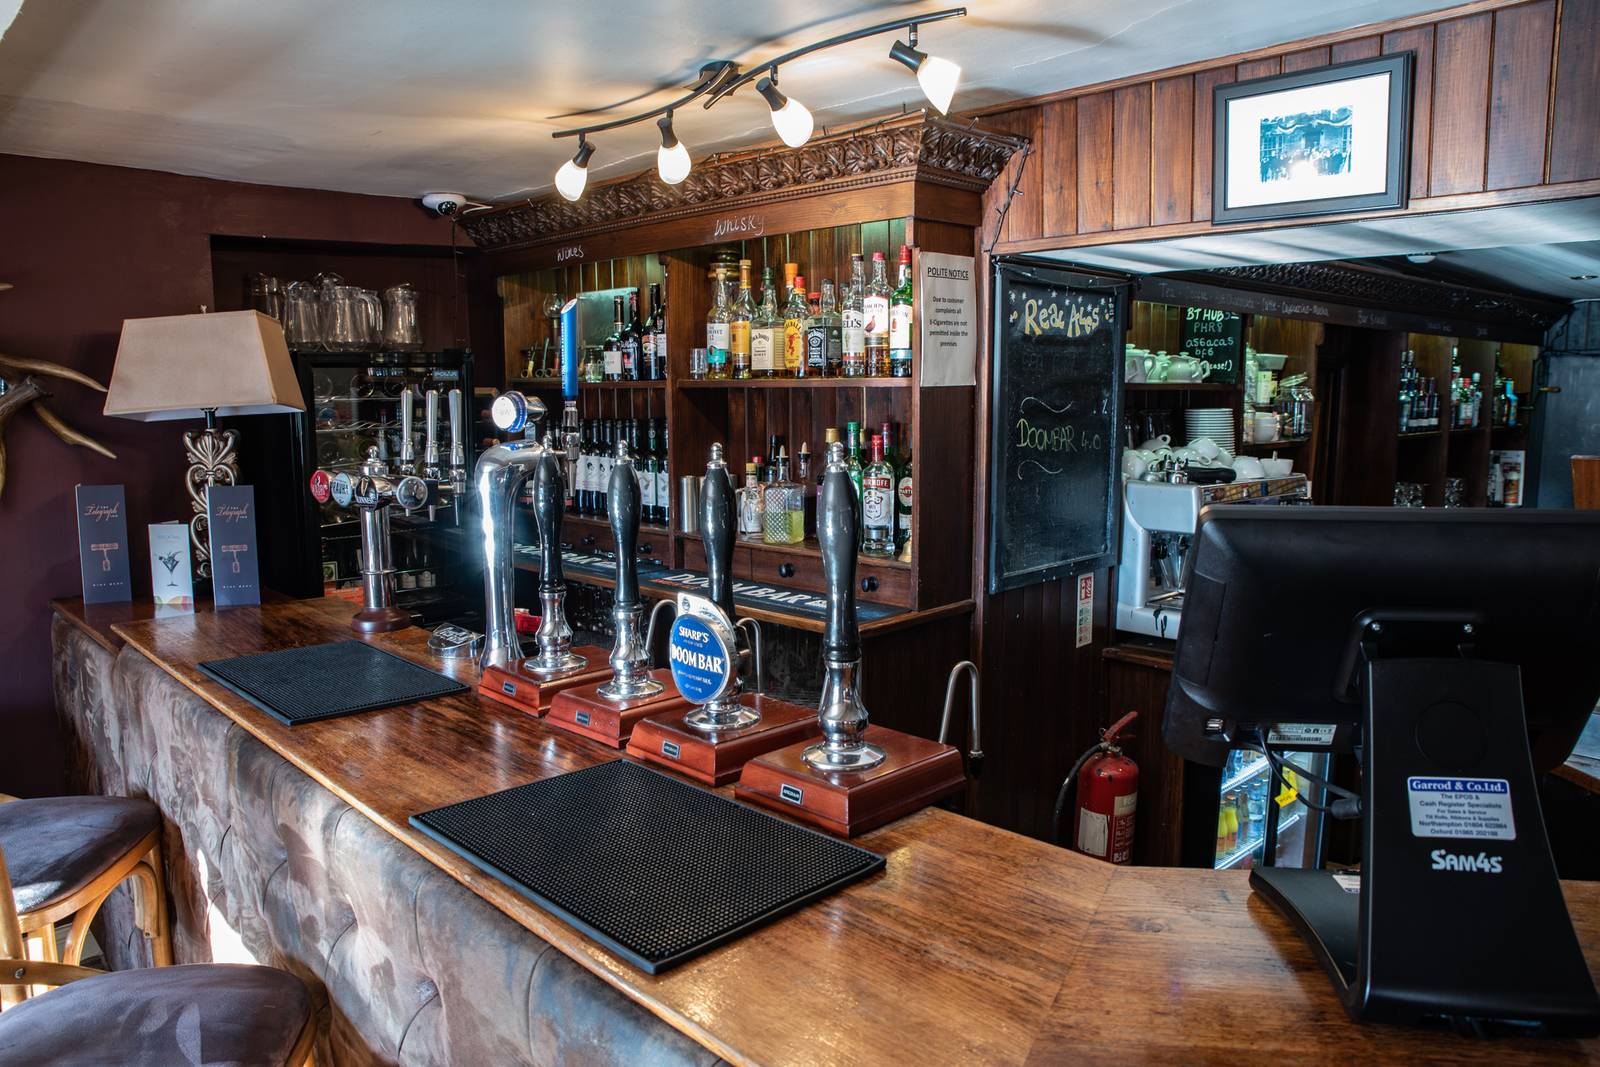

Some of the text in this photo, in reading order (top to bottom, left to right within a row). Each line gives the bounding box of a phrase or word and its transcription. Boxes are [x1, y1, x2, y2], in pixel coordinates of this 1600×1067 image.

[927, 266, 969, 279] POLITE NOTICE
[1186, 306, 1224, 322] BT HUB
[678, 625, 710, 643] SHARP'S
[671, 642, 723, 675] DOOM BAR
[1412, 780, 1452, 791] Garrod
[1454, 780, 1463, 791] &
[1438, 801, 1465, 809] Register
[1467, 801, 1502, 809] Specialists
[1418, 820, 1463, 829] Northampton
